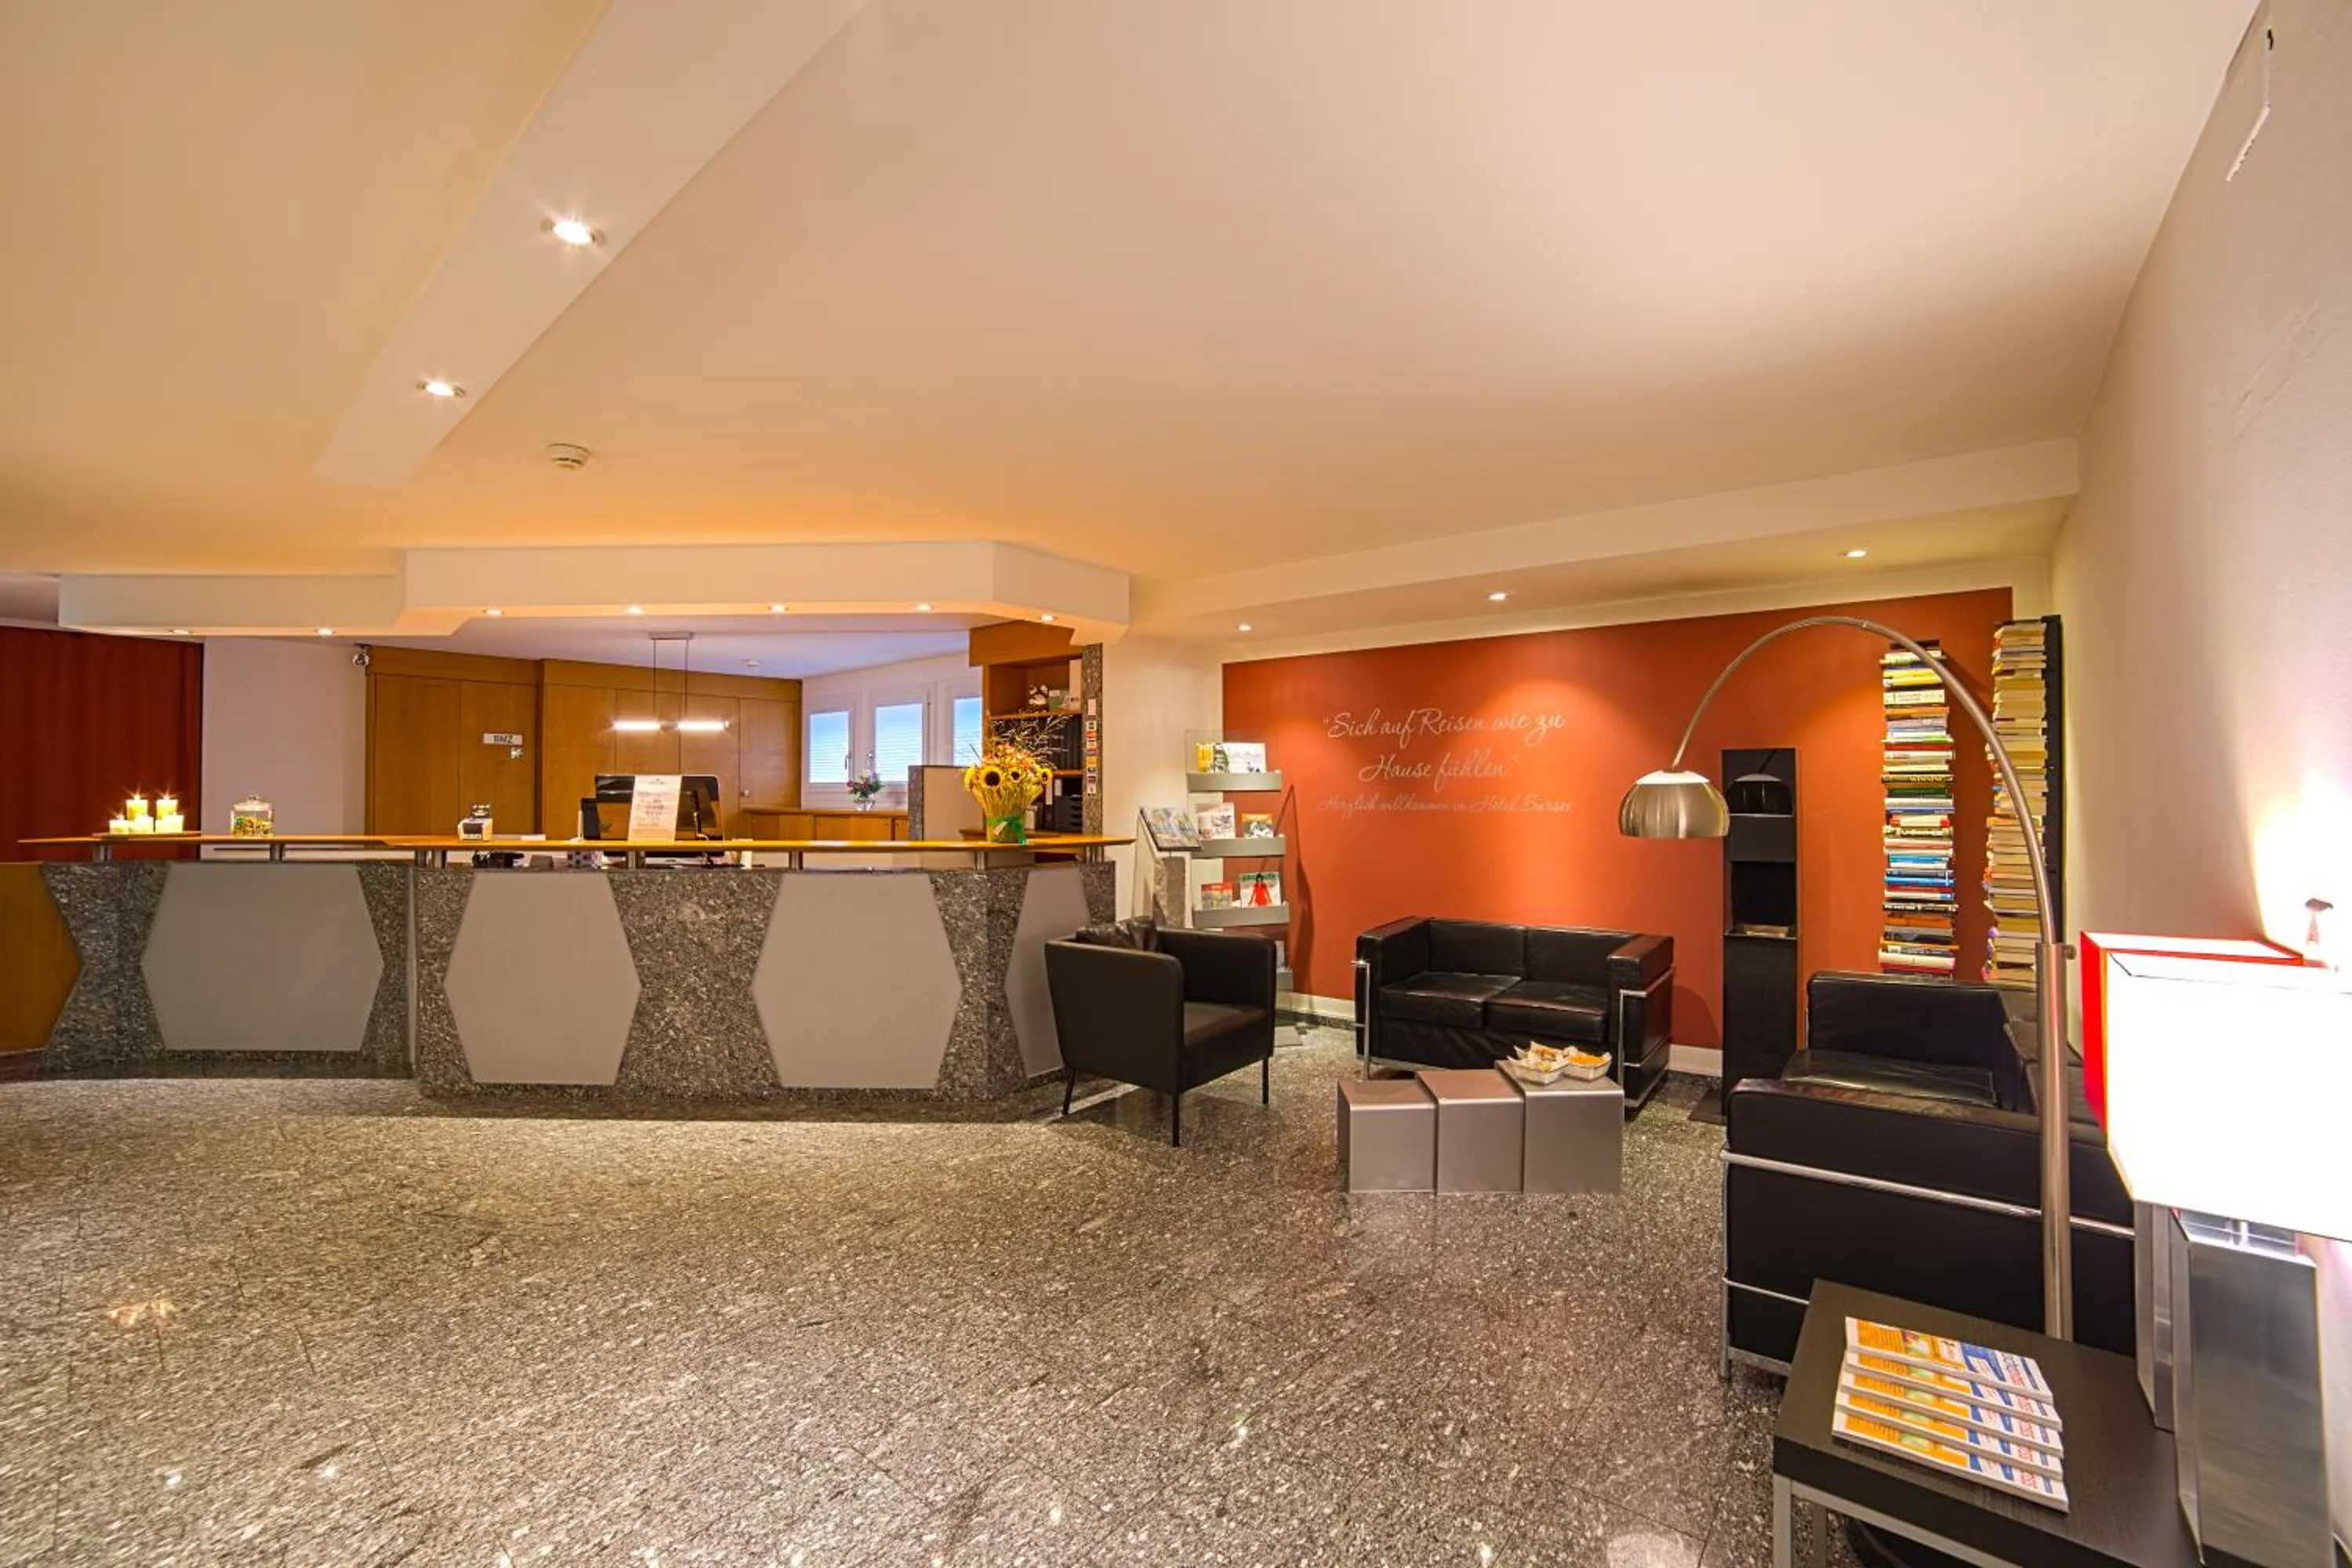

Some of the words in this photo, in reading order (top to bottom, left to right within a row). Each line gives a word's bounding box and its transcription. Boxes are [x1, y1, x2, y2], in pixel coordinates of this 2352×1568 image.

[1381, 708, 1417, 750] auf
[1417, 707, 1485, 736] Reisen
[1491, 712, 1528, 731] wie
[1524, 712, 1567, 747] zu
[1358, 753, 1432, 782] Hause
